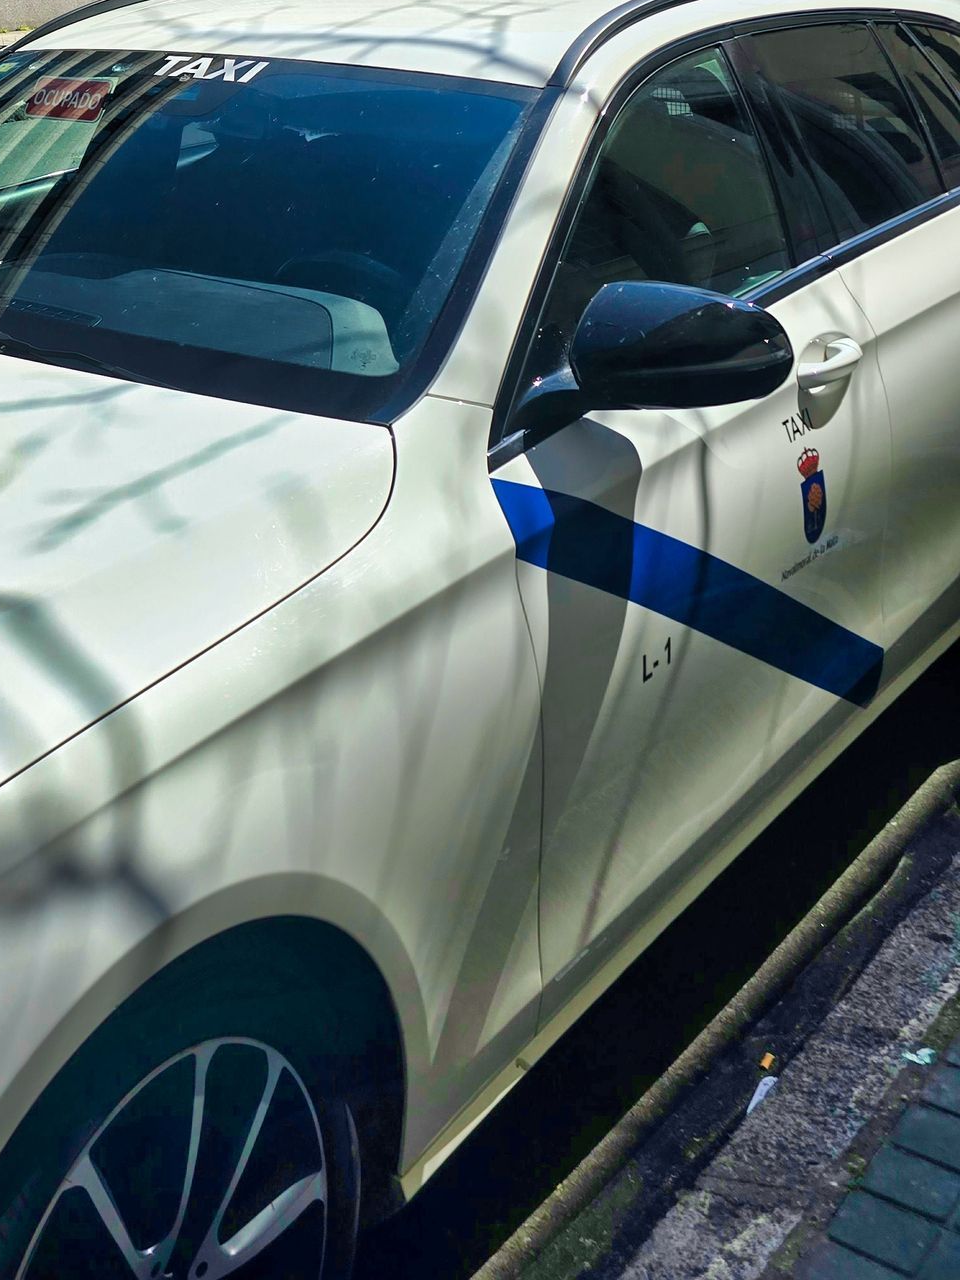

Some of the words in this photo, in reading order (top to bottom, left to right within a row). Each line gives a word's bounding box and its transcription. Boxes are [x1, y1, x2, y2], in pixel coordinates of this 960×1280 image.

[154, 55, 270, 84] TAXI
[34, 89, 102, 110] OCUPADO
[782, 408, 814, 443] TAXI
